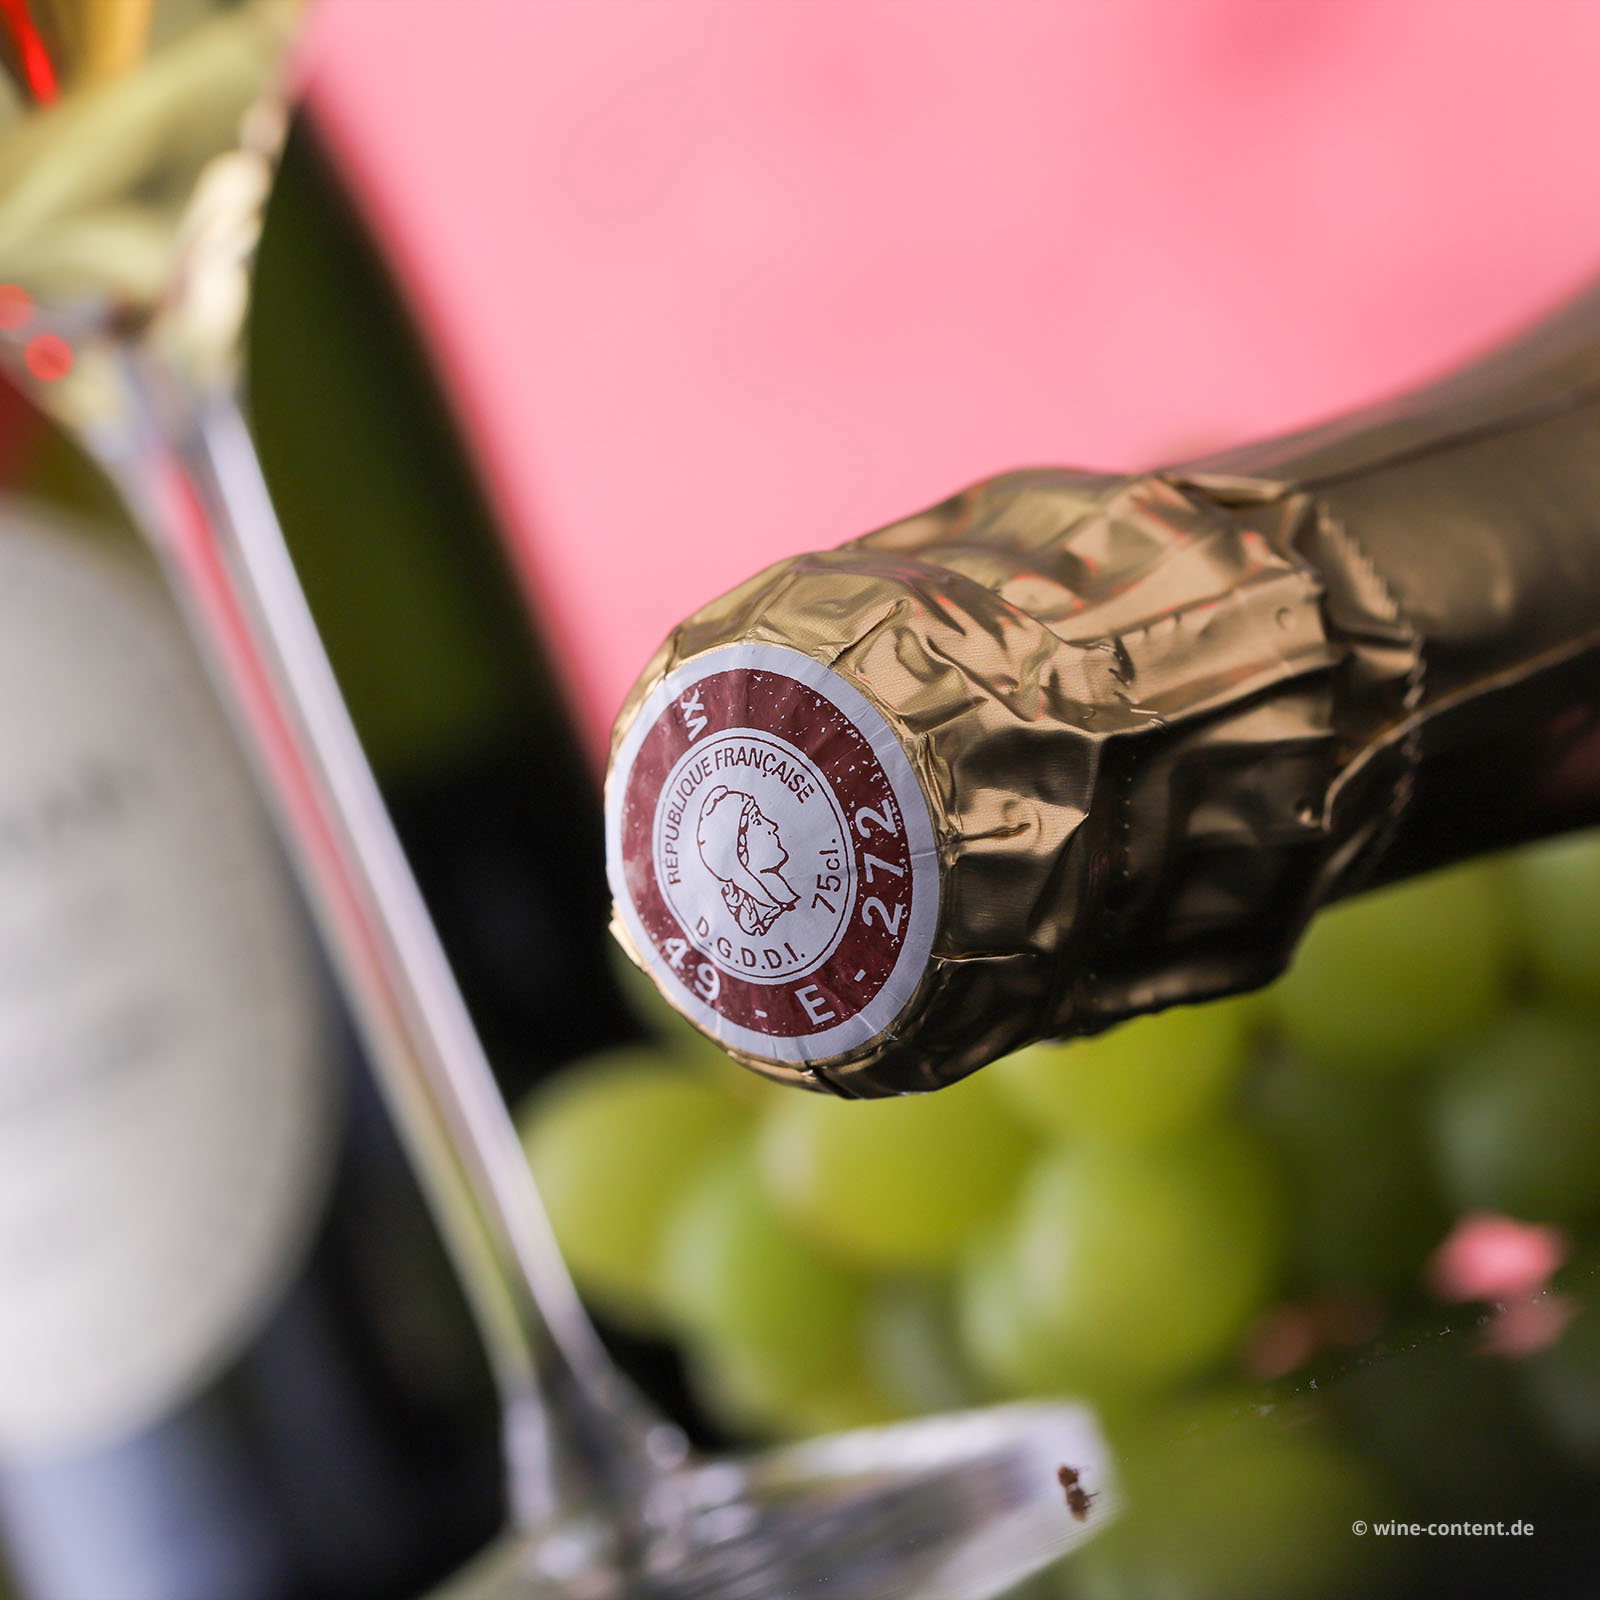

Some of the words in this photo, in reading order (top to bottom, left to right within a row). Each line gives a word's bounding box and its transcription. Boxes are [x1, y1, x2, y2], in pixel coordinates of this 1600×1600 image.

[664, 756, 713, 885] REPUBLIQUE
[714, 745, 815, 804] FRANÇAISE
[794, 983, 837, 1026] E
[855, 799, 904, 936] 272
[811, 838, 842, 914] 75cl.
[696, 915, 806, 970] D.G.D.D.I.
